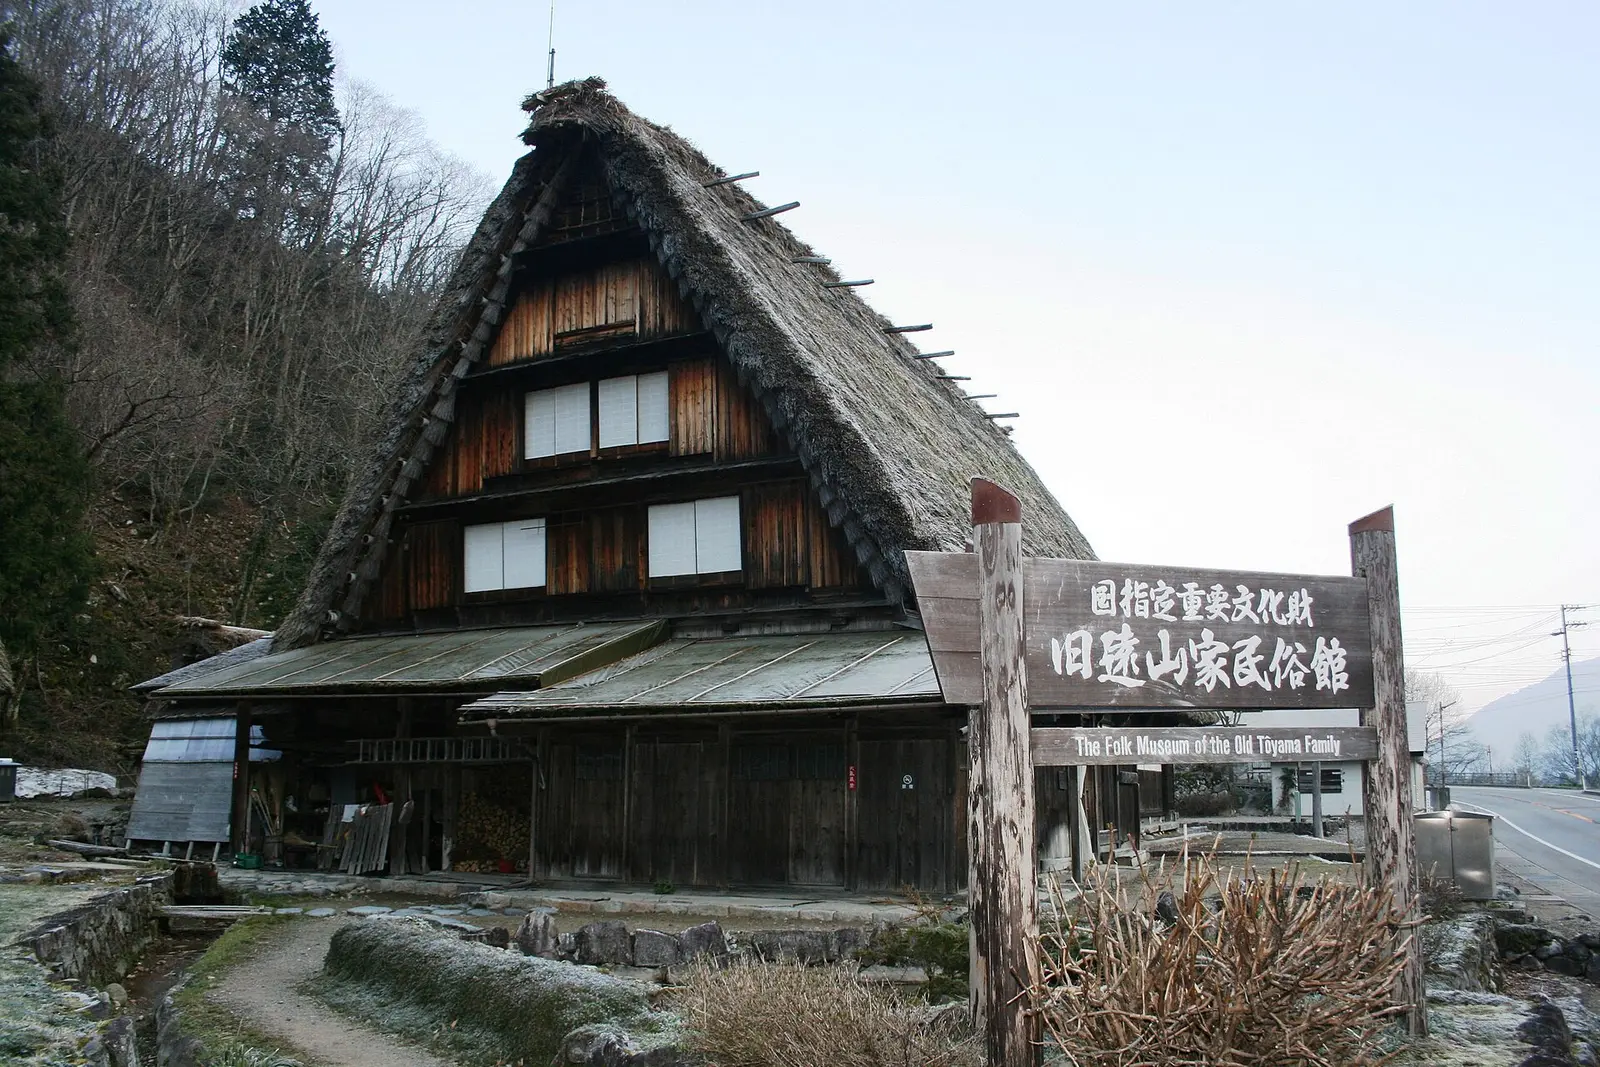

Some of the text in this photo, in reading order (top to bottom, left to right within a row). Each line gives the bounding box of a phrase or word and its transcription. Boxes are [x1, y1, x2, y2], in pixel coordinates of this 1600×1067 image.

[1051, 622, 1350, 695] 旧遠山家民俗館
[1075, 736, 1100, 757] The
[1105, 735, 1133, 757] Folk
[1136, 735, 1190, 756] Museum
[1194, 734, 1208, 755] of
[1210, 735, 1231, 755] the
[1234, 734, 1253, 755] Old
[1304, 734, 1341, 757] Family
